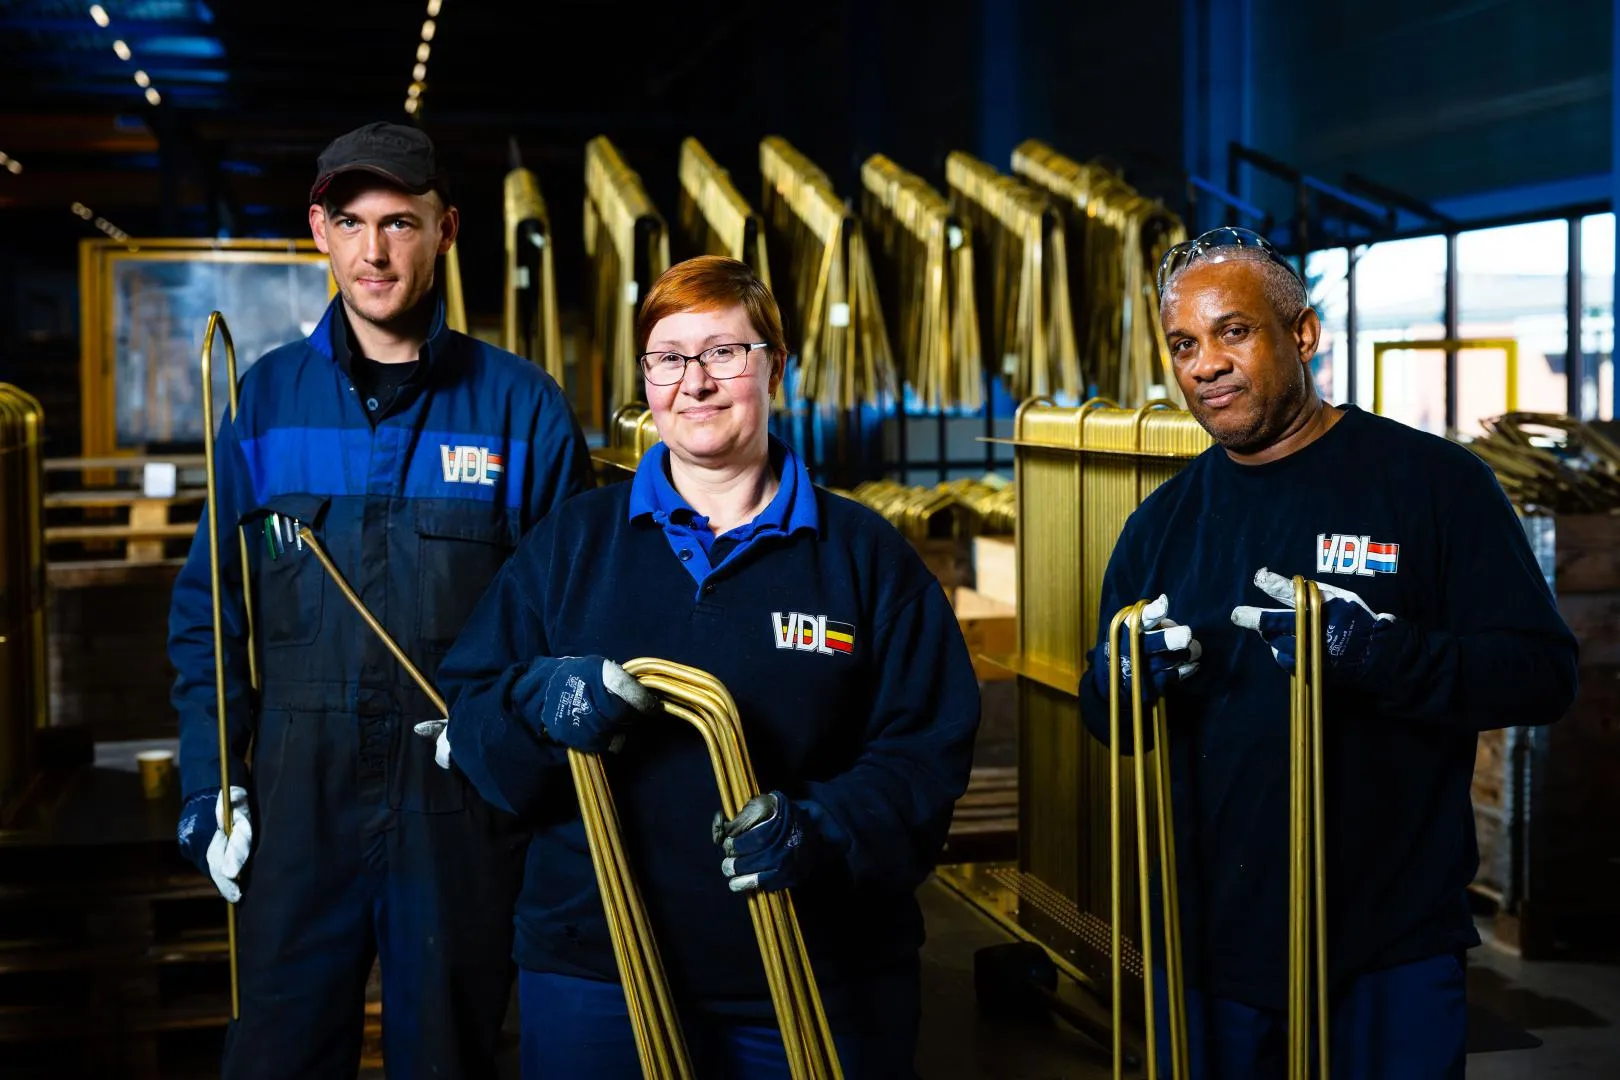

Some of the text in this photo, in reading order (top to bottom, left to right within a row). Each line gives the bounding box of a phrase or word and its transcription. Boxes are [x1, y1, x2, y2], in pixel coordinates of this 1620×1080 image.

[440, 444, 495, 486] VDL
[1317, 534, 1375, 577] VDL
[771, 612, 834, 656] VDL
